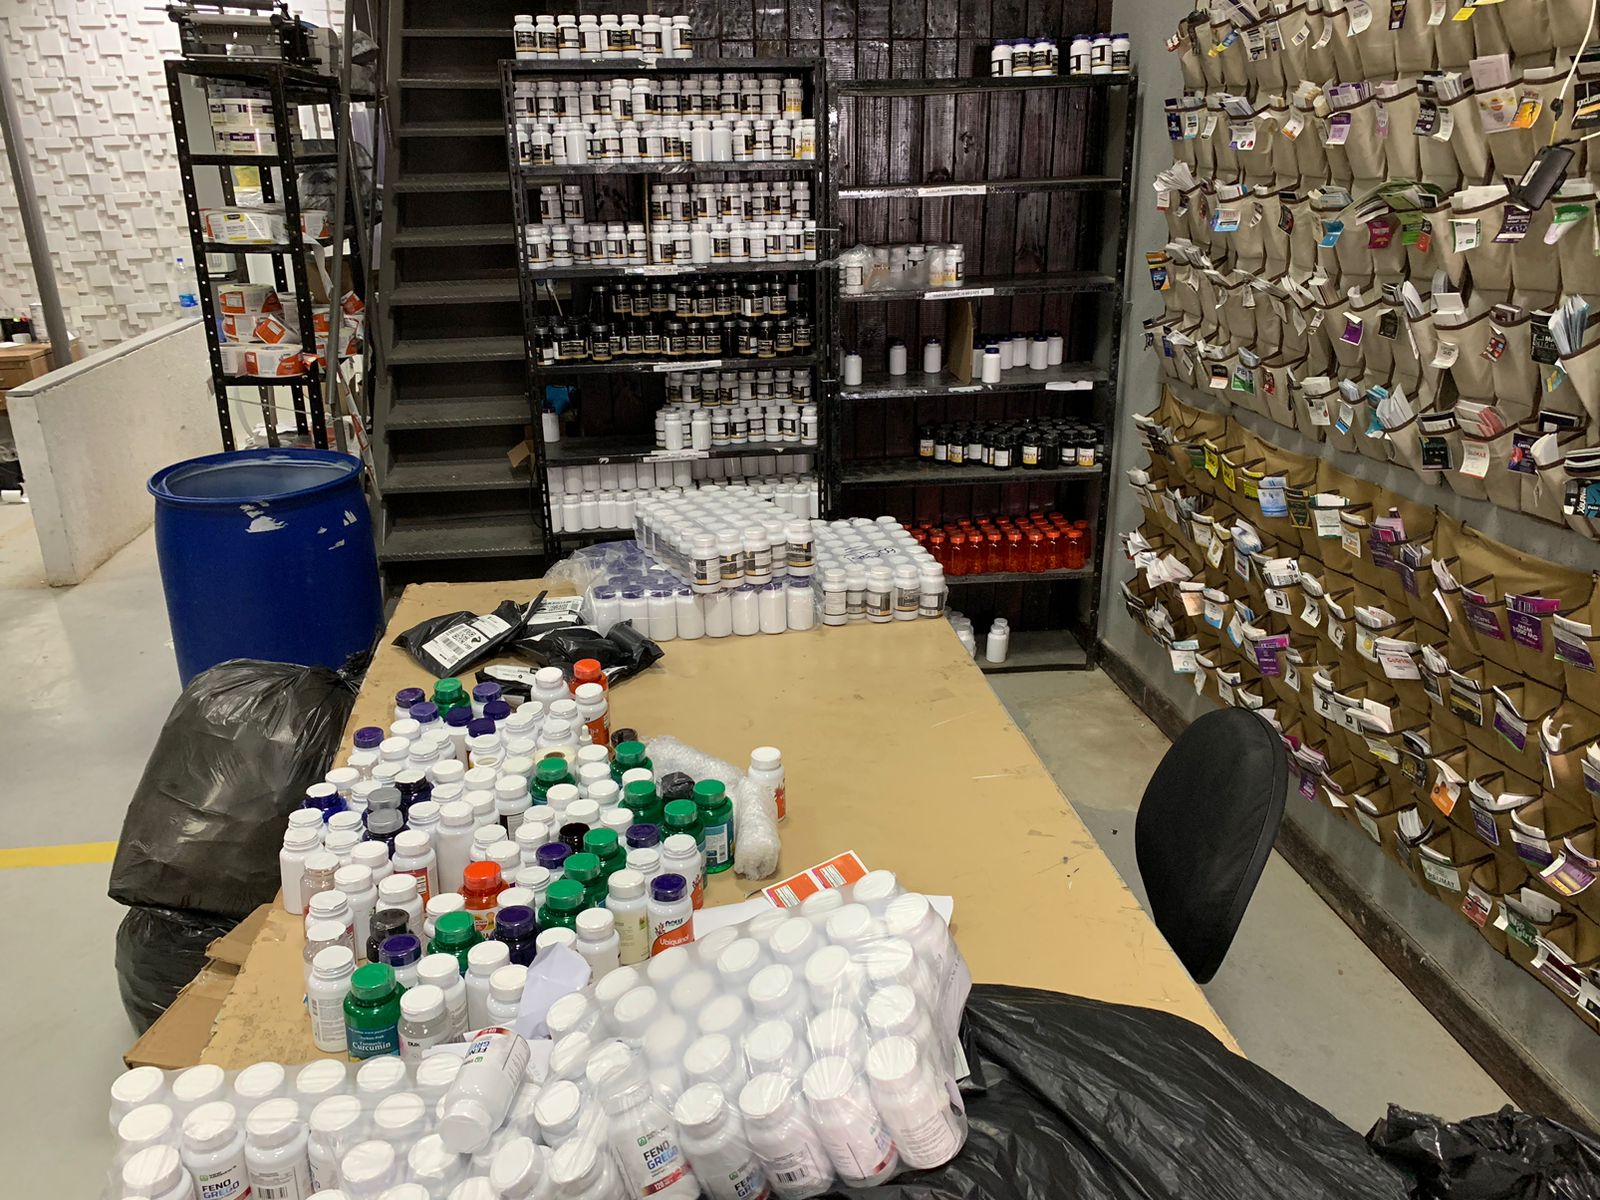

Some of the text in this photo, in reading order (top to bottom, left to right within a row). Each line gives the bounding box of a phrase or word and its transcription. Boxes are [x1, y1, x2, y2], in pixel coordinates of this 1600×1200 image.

[660, 934, 689, 946] Ubiquinol
[352, 1041, 391, 1051] Curcumin
[643, 1140, 670, 1161] FENO
[646, 1145, 680, 1170] GREGO
[202, 1179, 232, 1192] FENO
[203, 1180, 240, 1199] GREGO
